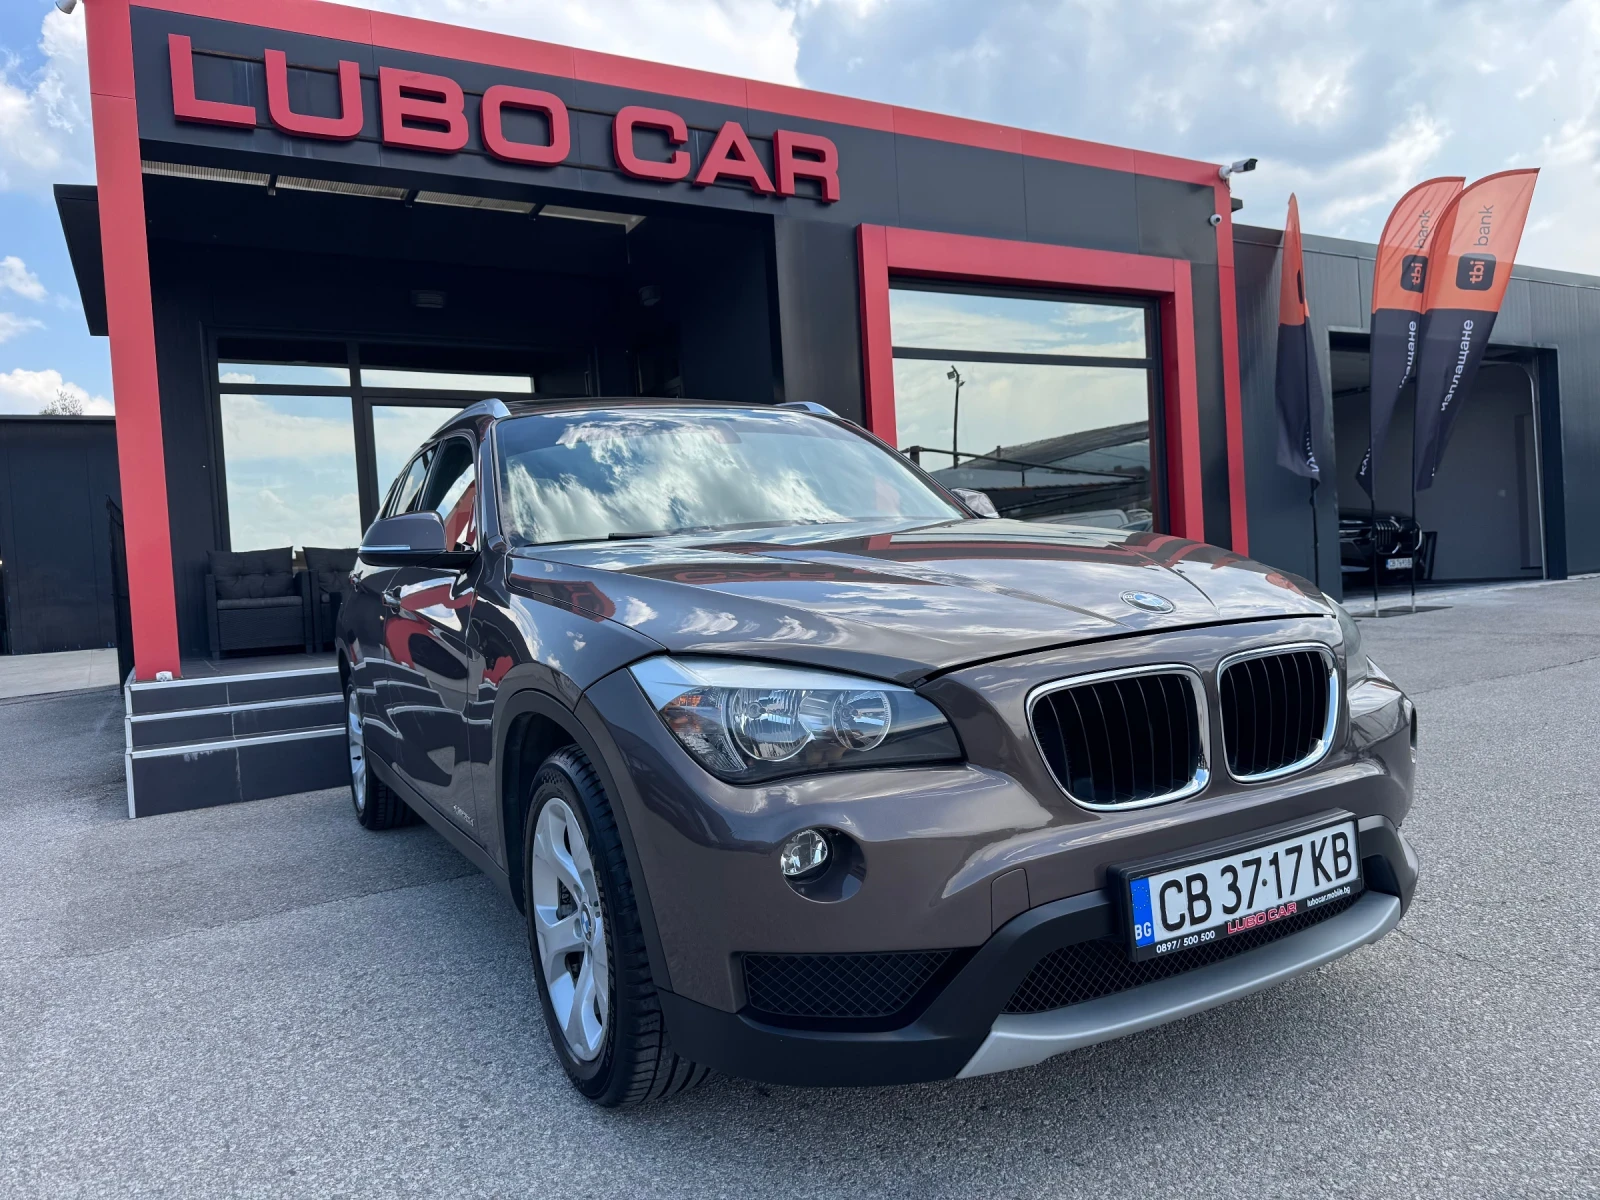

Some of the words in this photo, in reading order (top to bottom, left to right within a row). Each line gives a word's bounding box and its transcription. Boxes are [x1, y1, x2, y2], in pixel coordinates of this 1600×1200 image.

[167, 34, 571, 167] LUBO
[611, 105, 841, 203] CAR
[1414, 209, 1431, 249] bank
[1473, 204, 1494, 246] bank
[1411, 263, 1423, 285] tbi
[1469, 260, 1485, 284] tbi
[1441, 319, 1474, 411] изплащане
[1159, 872, 1212, 932] CB
[1310, 831, 1353, 887] KB
[1306, 886, 1351, 907] lubocar.mobile.bg
[1134, 922, 1152, 940] BG
[1227, 911, 1267, 934] LUBO
[1267, 902, 1297, 921] CAR
[1156, 939, 1181, 953] 0897/
[1183, 935, 1199, 946] 500
[1200, 930, 1216, 941] 500
